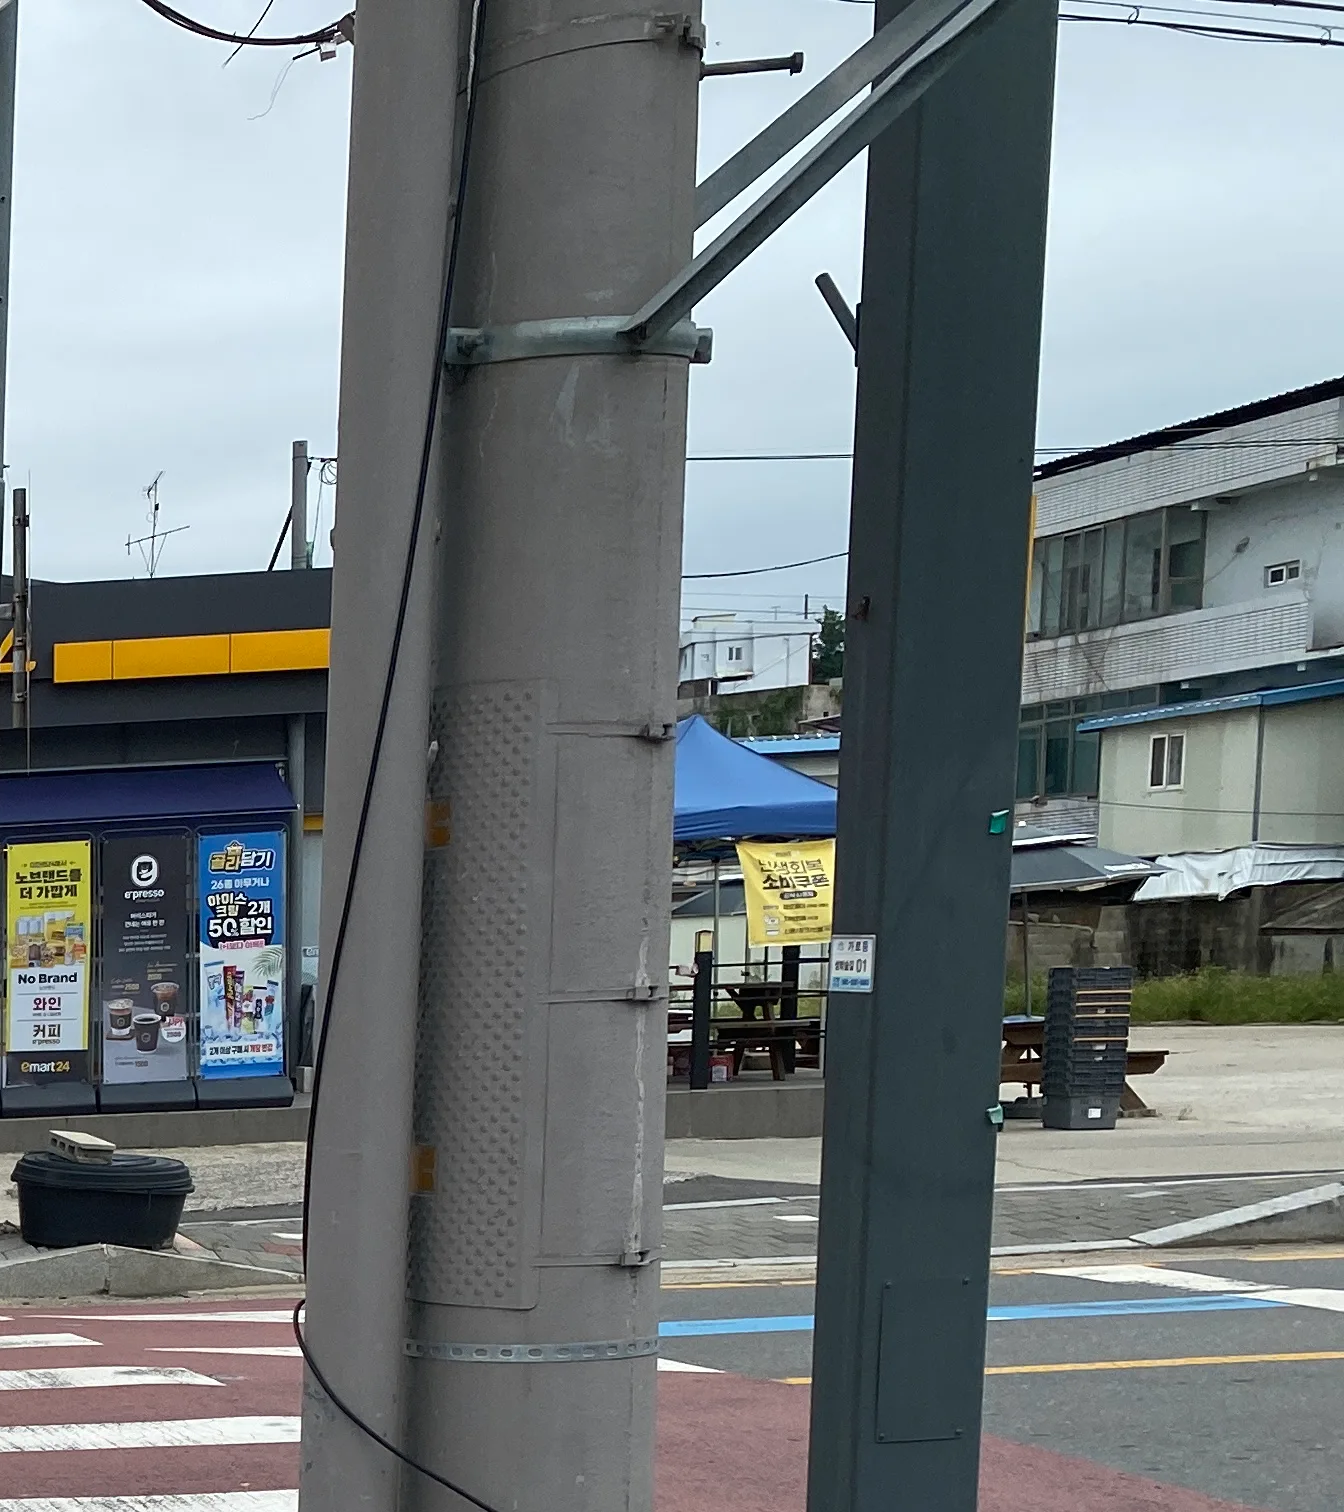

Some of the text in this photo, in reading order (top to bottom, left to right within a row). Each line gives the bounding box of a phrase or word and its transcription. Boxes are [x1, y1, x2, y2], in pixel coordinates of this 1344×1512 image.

[234, 877, 270, 888] 아무거나
[20, 884, 78, 899] 더 가깝게
[207, 893, 248, 907] 아이스
[247, 901, 271, 915] 2개
[18, 972, 78, 984] No Brand
[33, 996, 61, 1011] 와인
[32, 1024, 61, 1038] 커피
[21, 1061, 70, 1073] emart24
